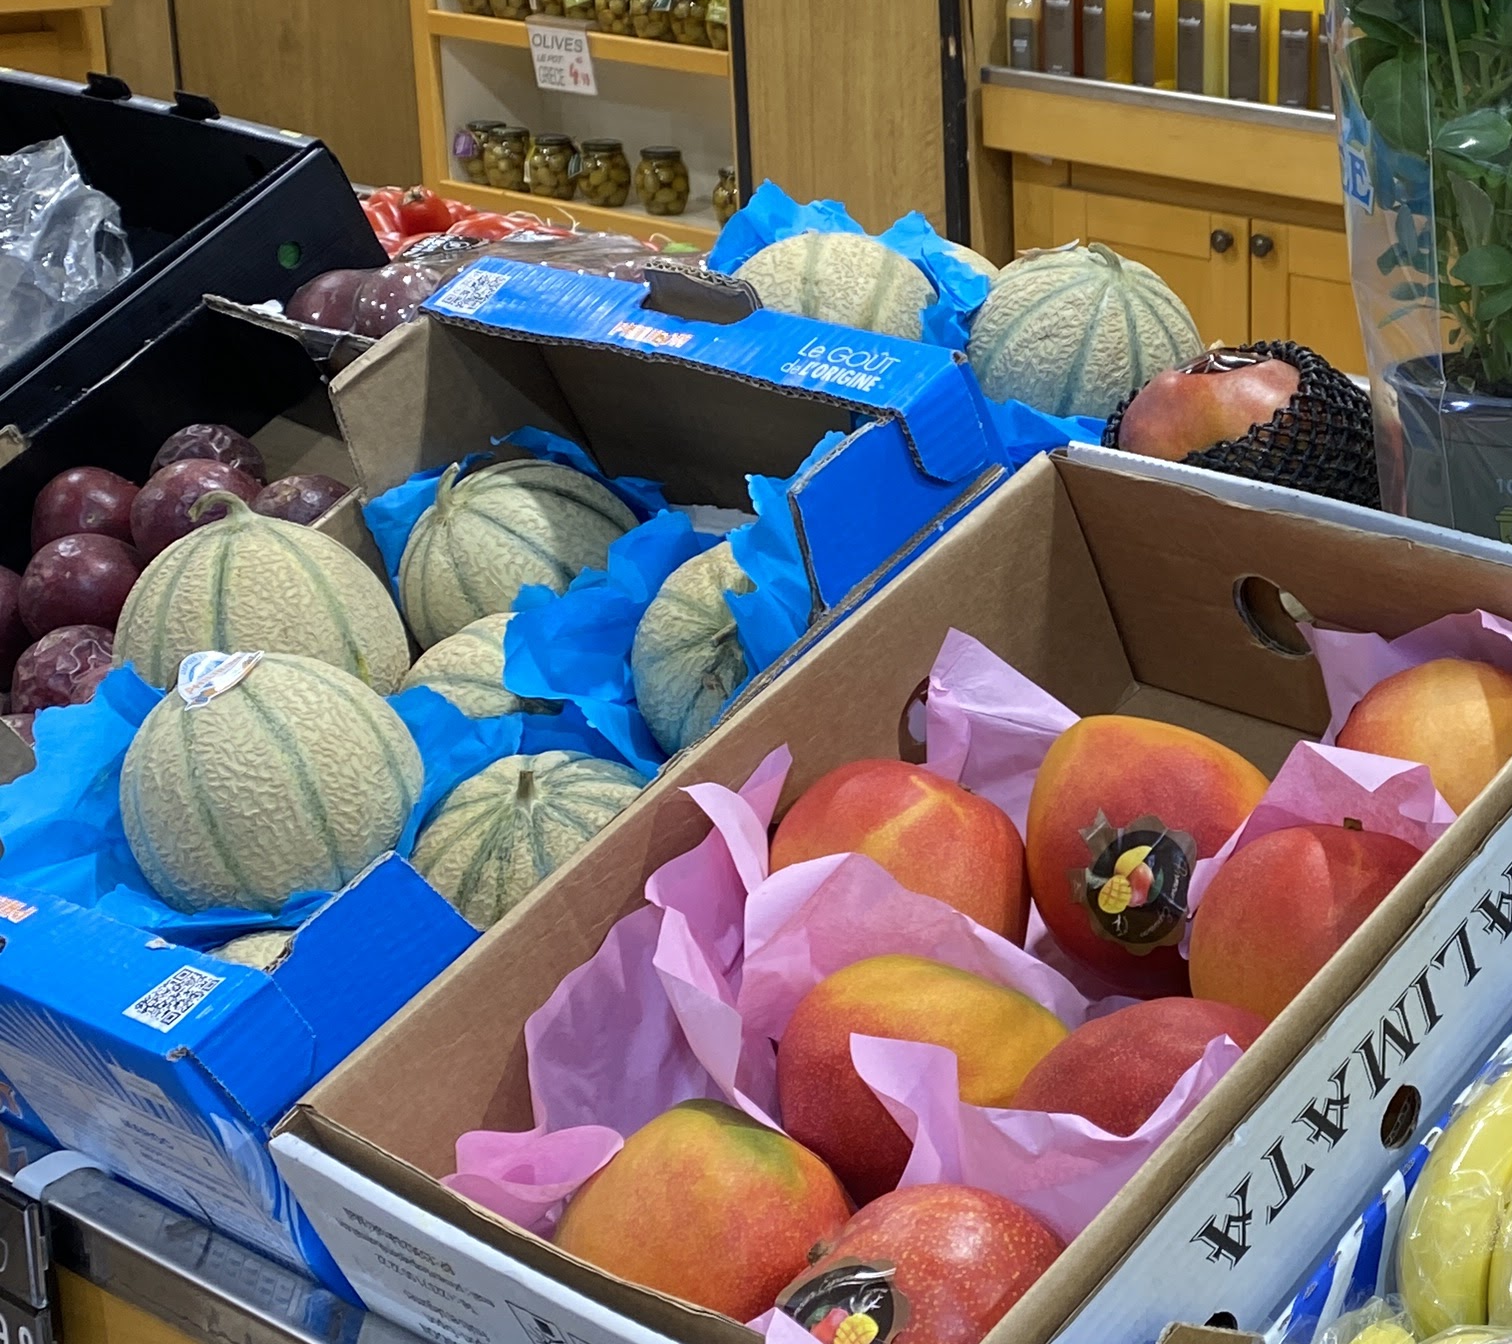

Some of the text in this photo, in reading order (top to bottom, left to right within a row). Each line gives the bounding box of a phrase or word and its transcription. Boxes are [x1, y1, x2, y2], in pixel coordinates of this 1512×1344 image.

[531, 33, 583, 53] OLIVES
[798, 336, 902, 374] Le GOÛT
[780, 360, 882, 393] de L'ORIGINE
